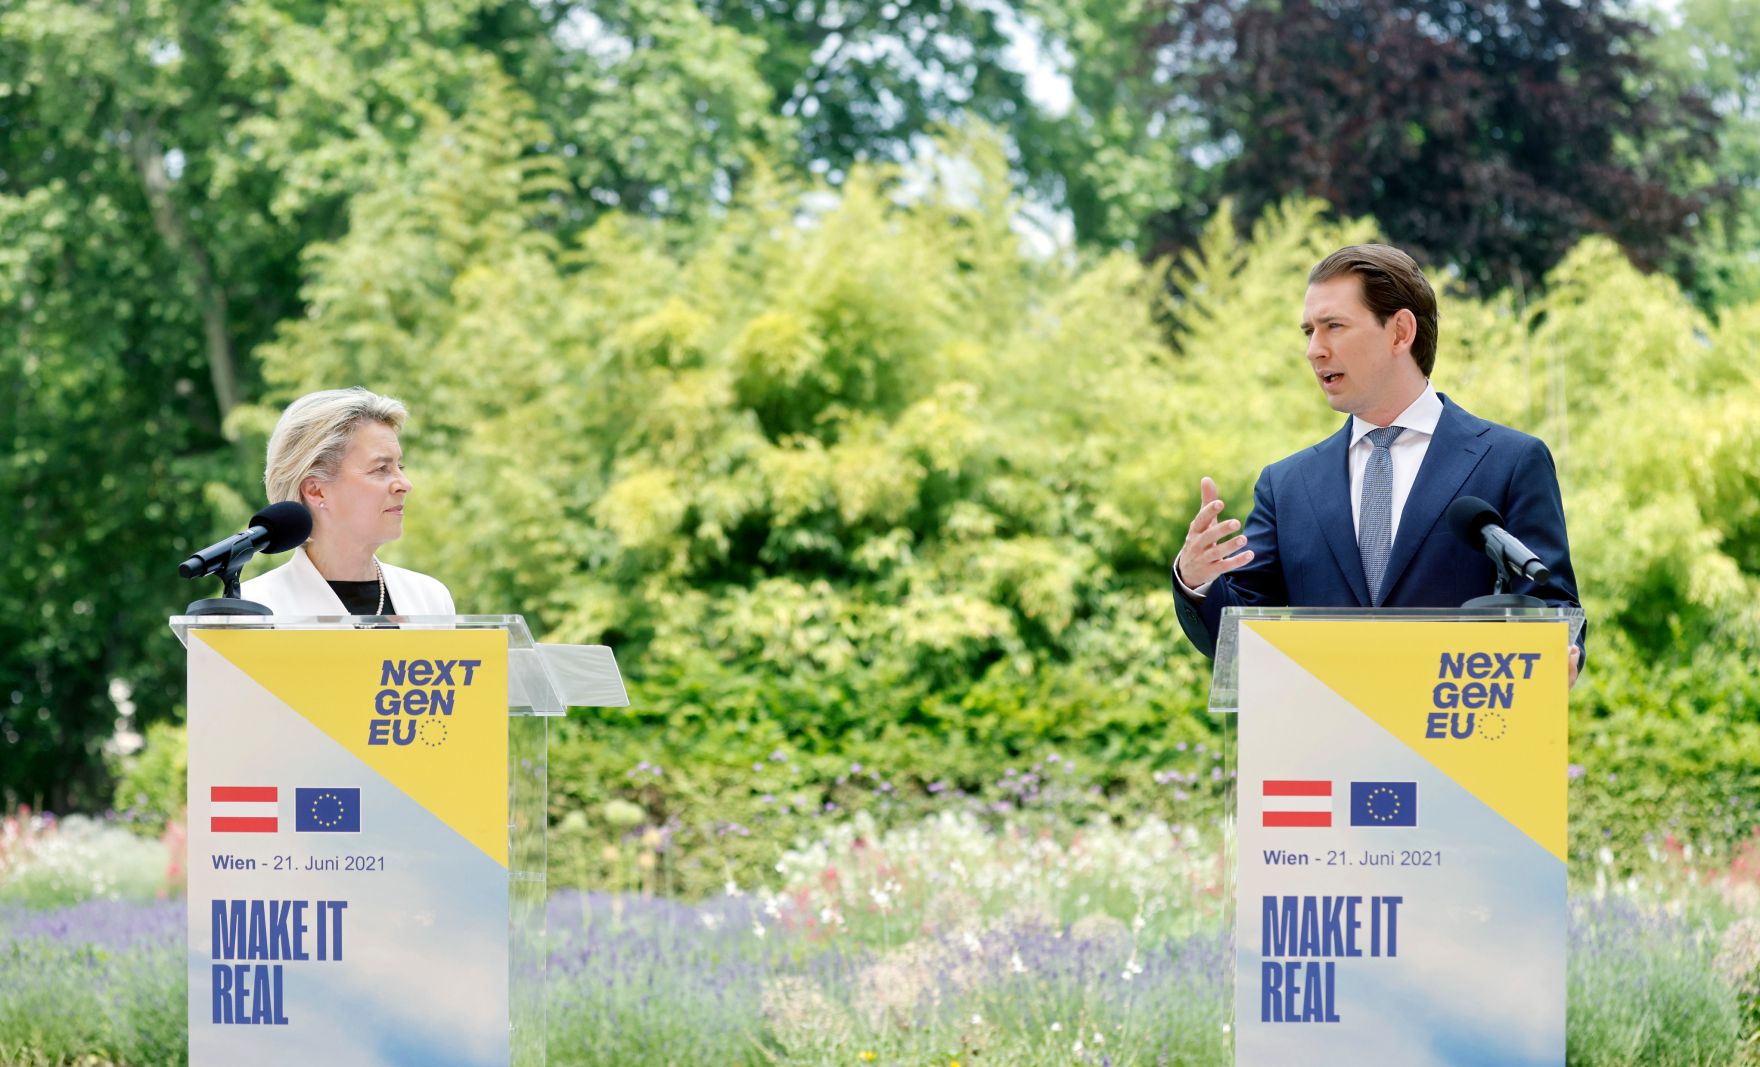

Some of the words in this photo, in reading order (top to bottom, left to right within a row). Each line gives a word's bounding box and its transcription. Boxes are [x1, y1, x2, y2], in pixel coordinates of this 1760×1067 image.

[367, 719, 417, 746] EU
[1425, 712, 1475, 740] EU
[212, 854, 256, 871] Wien
[273, 856, 299, 871] 21.
[304, 856, 339, 871] Juni
[344, 856, 384, 871] 2021
[1263, 850, 1309, 866] Wien
[1327, 851, 1353, 866] 21.
[1359, 850, 1395, 866] Juni
[1400, 851, 1441, 866] 2021
[211, 899, 309, 961] MAKE
[316, 900, 348, 961] IT
[1262, 895, 1362, 957] MAKE
[1371, 896, 1403, 957] IT
[212, 964, 288, 1025] REAL
[1261, 961, 1340, 1023] REAL
